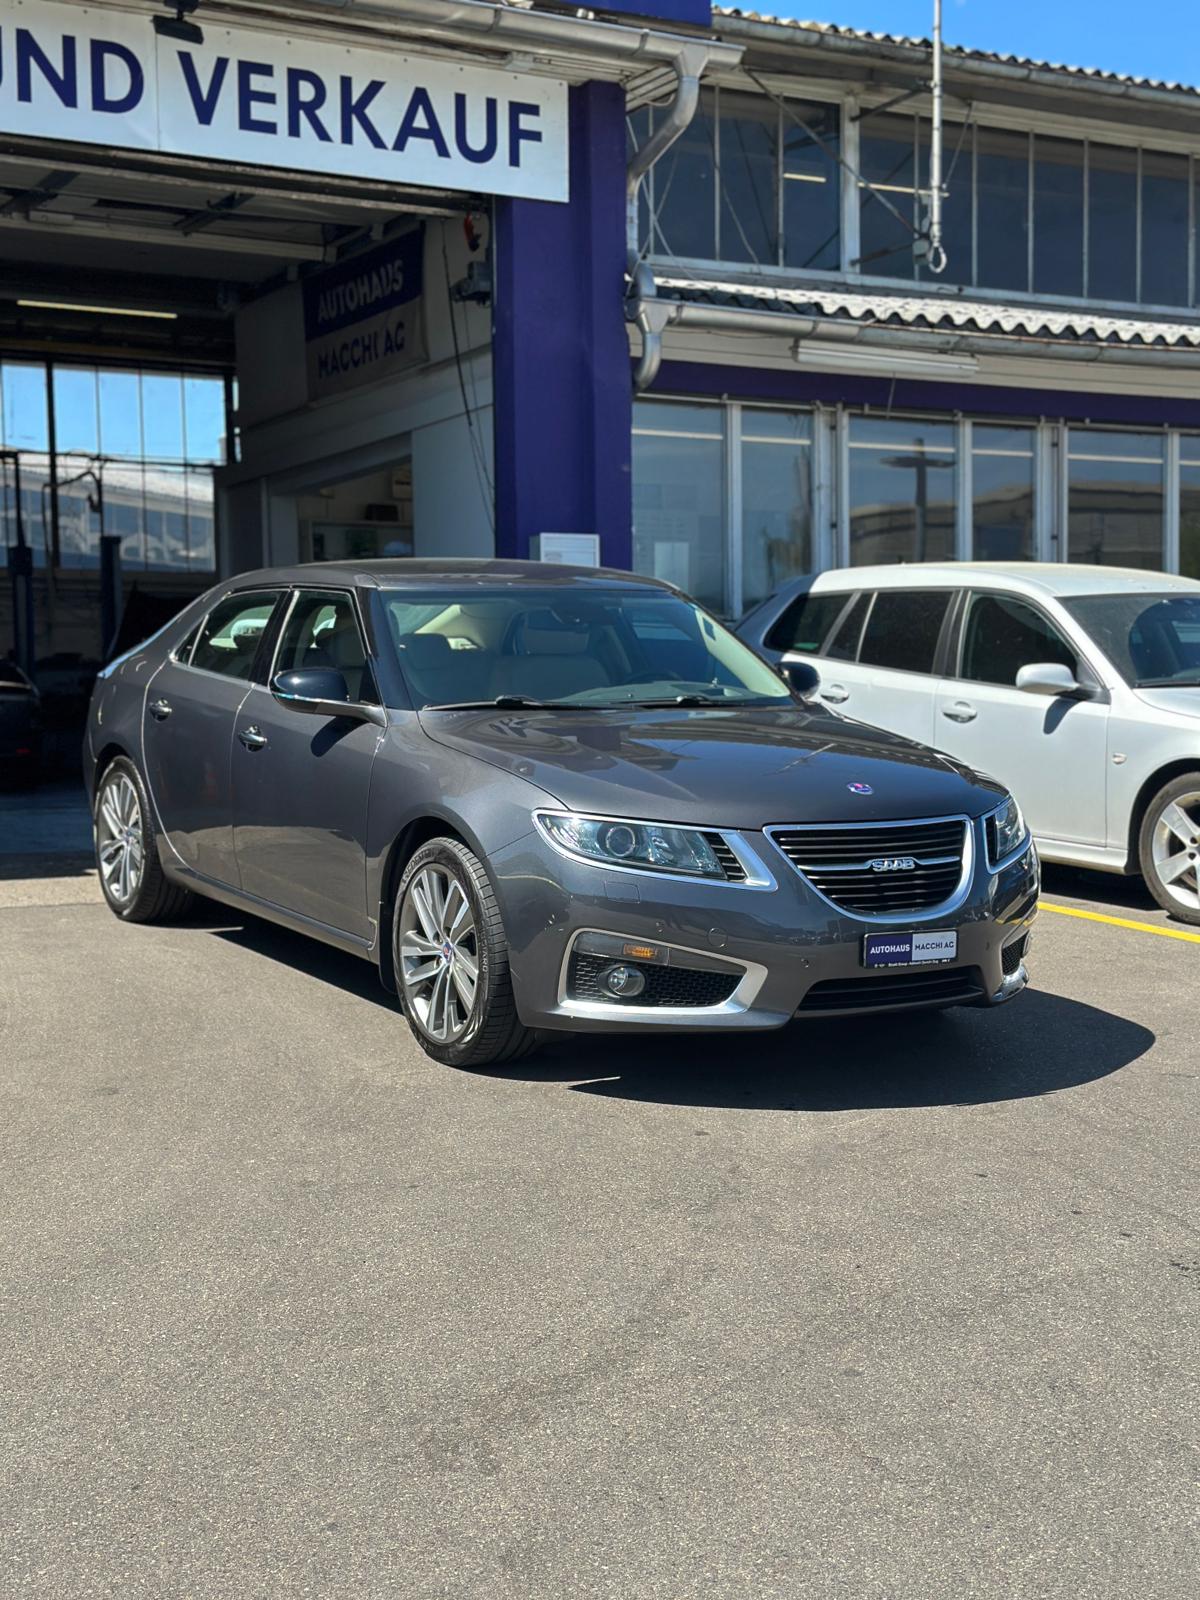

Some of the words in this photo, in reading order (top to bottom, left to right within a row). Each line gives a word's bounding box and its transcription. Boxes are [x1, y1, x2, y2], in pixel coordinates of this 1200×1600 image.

[0, 24, 145, 114] ND
[177, 50, 543, 168] VERKAUF
[318, 258, 404, 323] AUTOHAUS
[318, 331, 379, 378] MACCHI
[383, 319, 405, 357] AG
[872, 859, 915, 872] SAAB
[870, 943, 911, 954] AUTOHAUS
[914, 941, 943, 951] MACCHI
